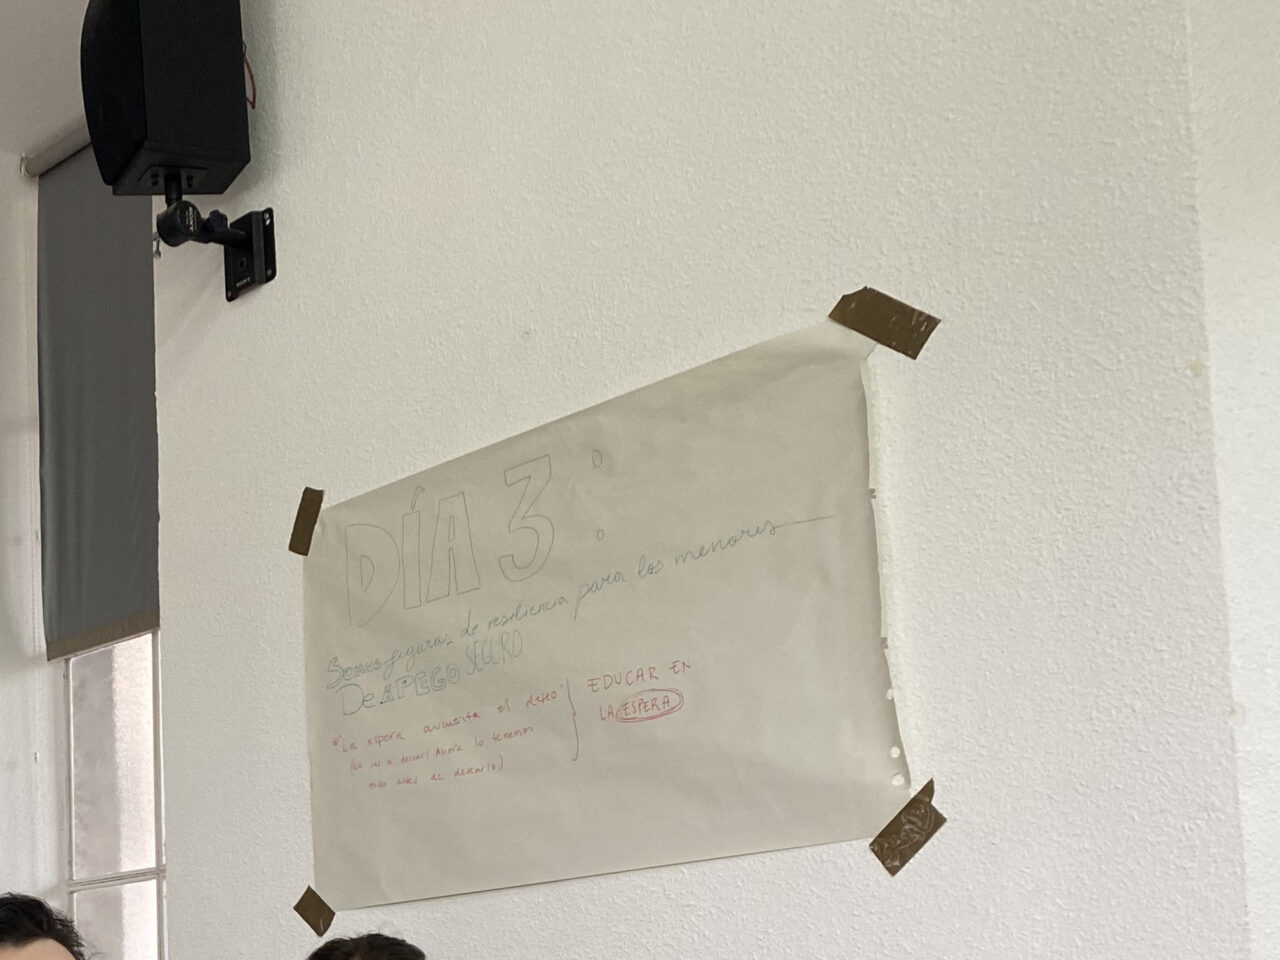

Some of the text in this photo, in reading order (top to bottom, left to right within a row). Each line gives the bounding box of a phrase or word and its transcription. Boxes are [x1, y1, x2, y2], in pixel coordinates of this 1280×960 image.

[344, 485, 482, 628] DÍA
[461, 608, 480, 639] de
[488, 595, 570, 630] resiliencia
[573, 571, 627, 622] para
[636, 555, 665, 580] los
[673, 519, 778, 567] menores
[379, 662, 462, 705] APEGO
[465, 629, 524, 676] SEGURO
[587, 659, 692, 693] EDUCAR EN
[367, 730, 408, 750] espera
[497, 698, 512, 713] el
[599, 694, 671, 721] LA ESPERA
[474, 736, 486, 748] lo
[491, 726, 535, 744] tenemos
